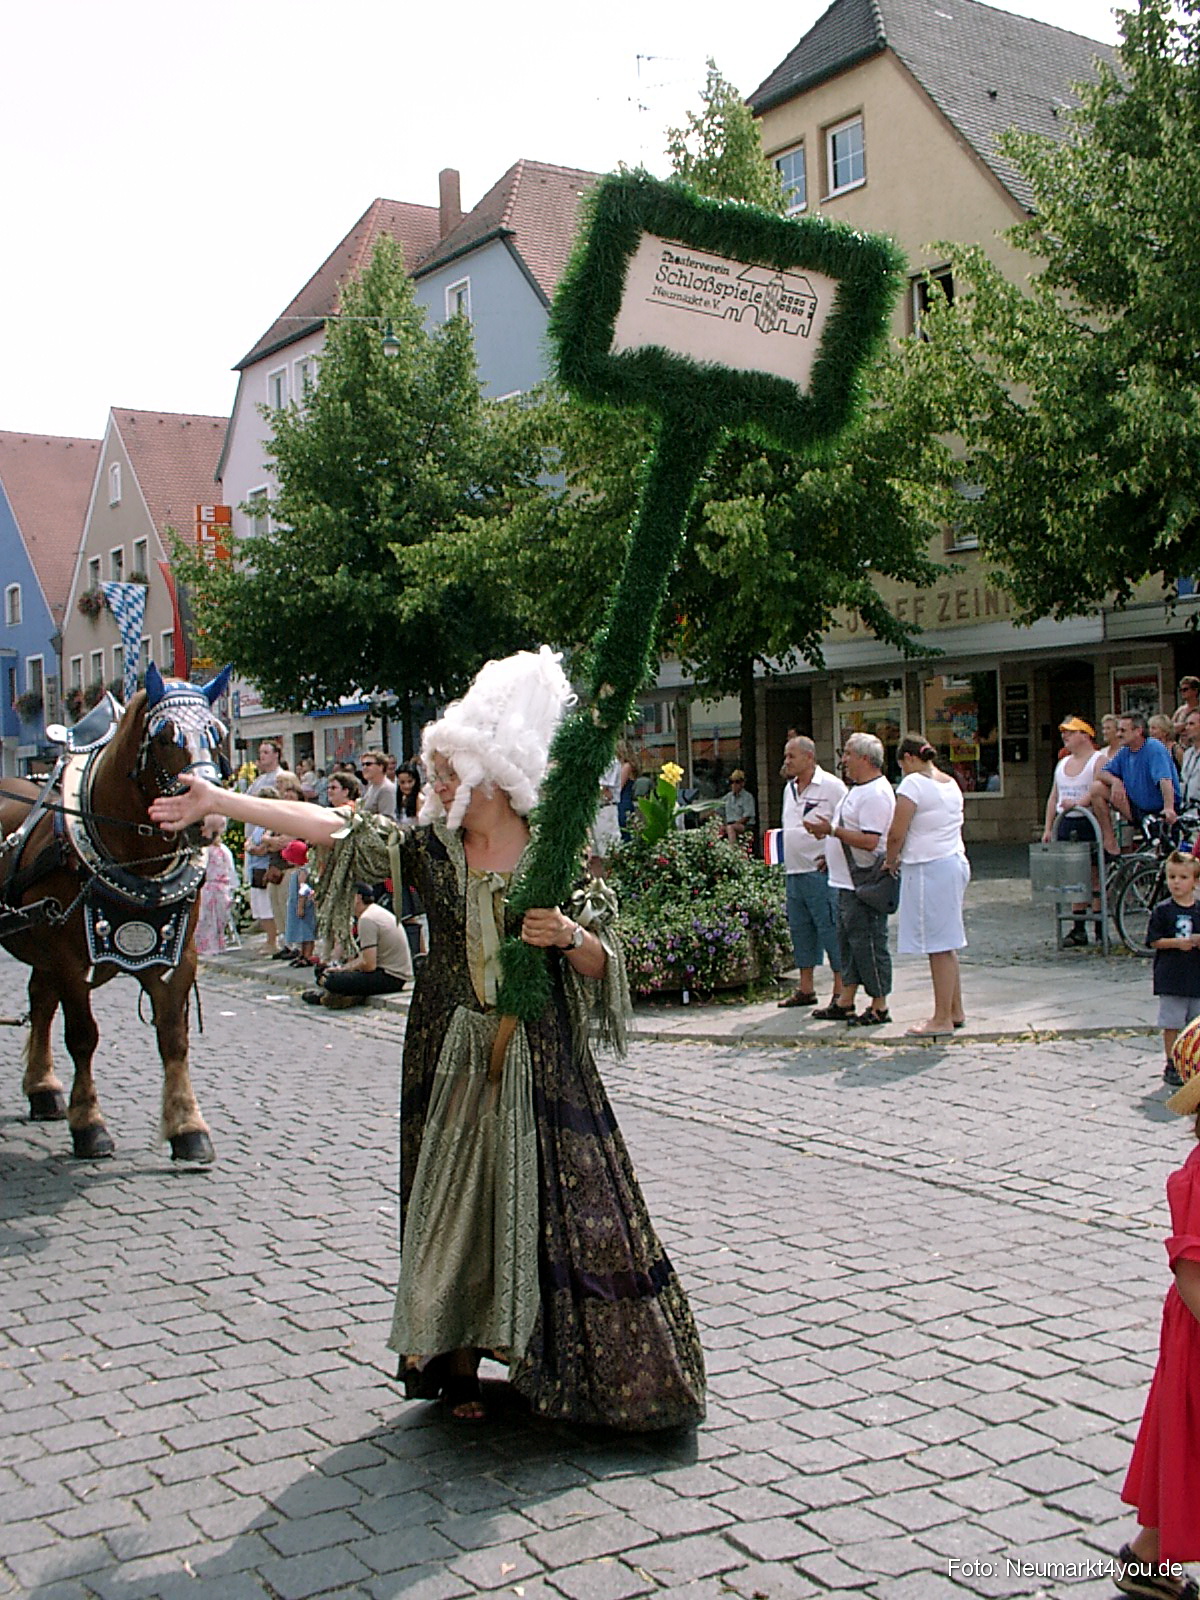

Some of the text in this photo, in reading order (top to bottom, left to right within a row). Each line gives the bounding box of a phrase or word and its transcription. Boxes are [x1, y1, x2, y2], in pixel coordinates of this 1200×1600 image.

[661, 249, 730, 276] Theaterverein
[652, 285, 703, 306] Neumarkt
[655, 264, 763, 304] Schloßspiele
[846, 595, 926, 633] JEF
